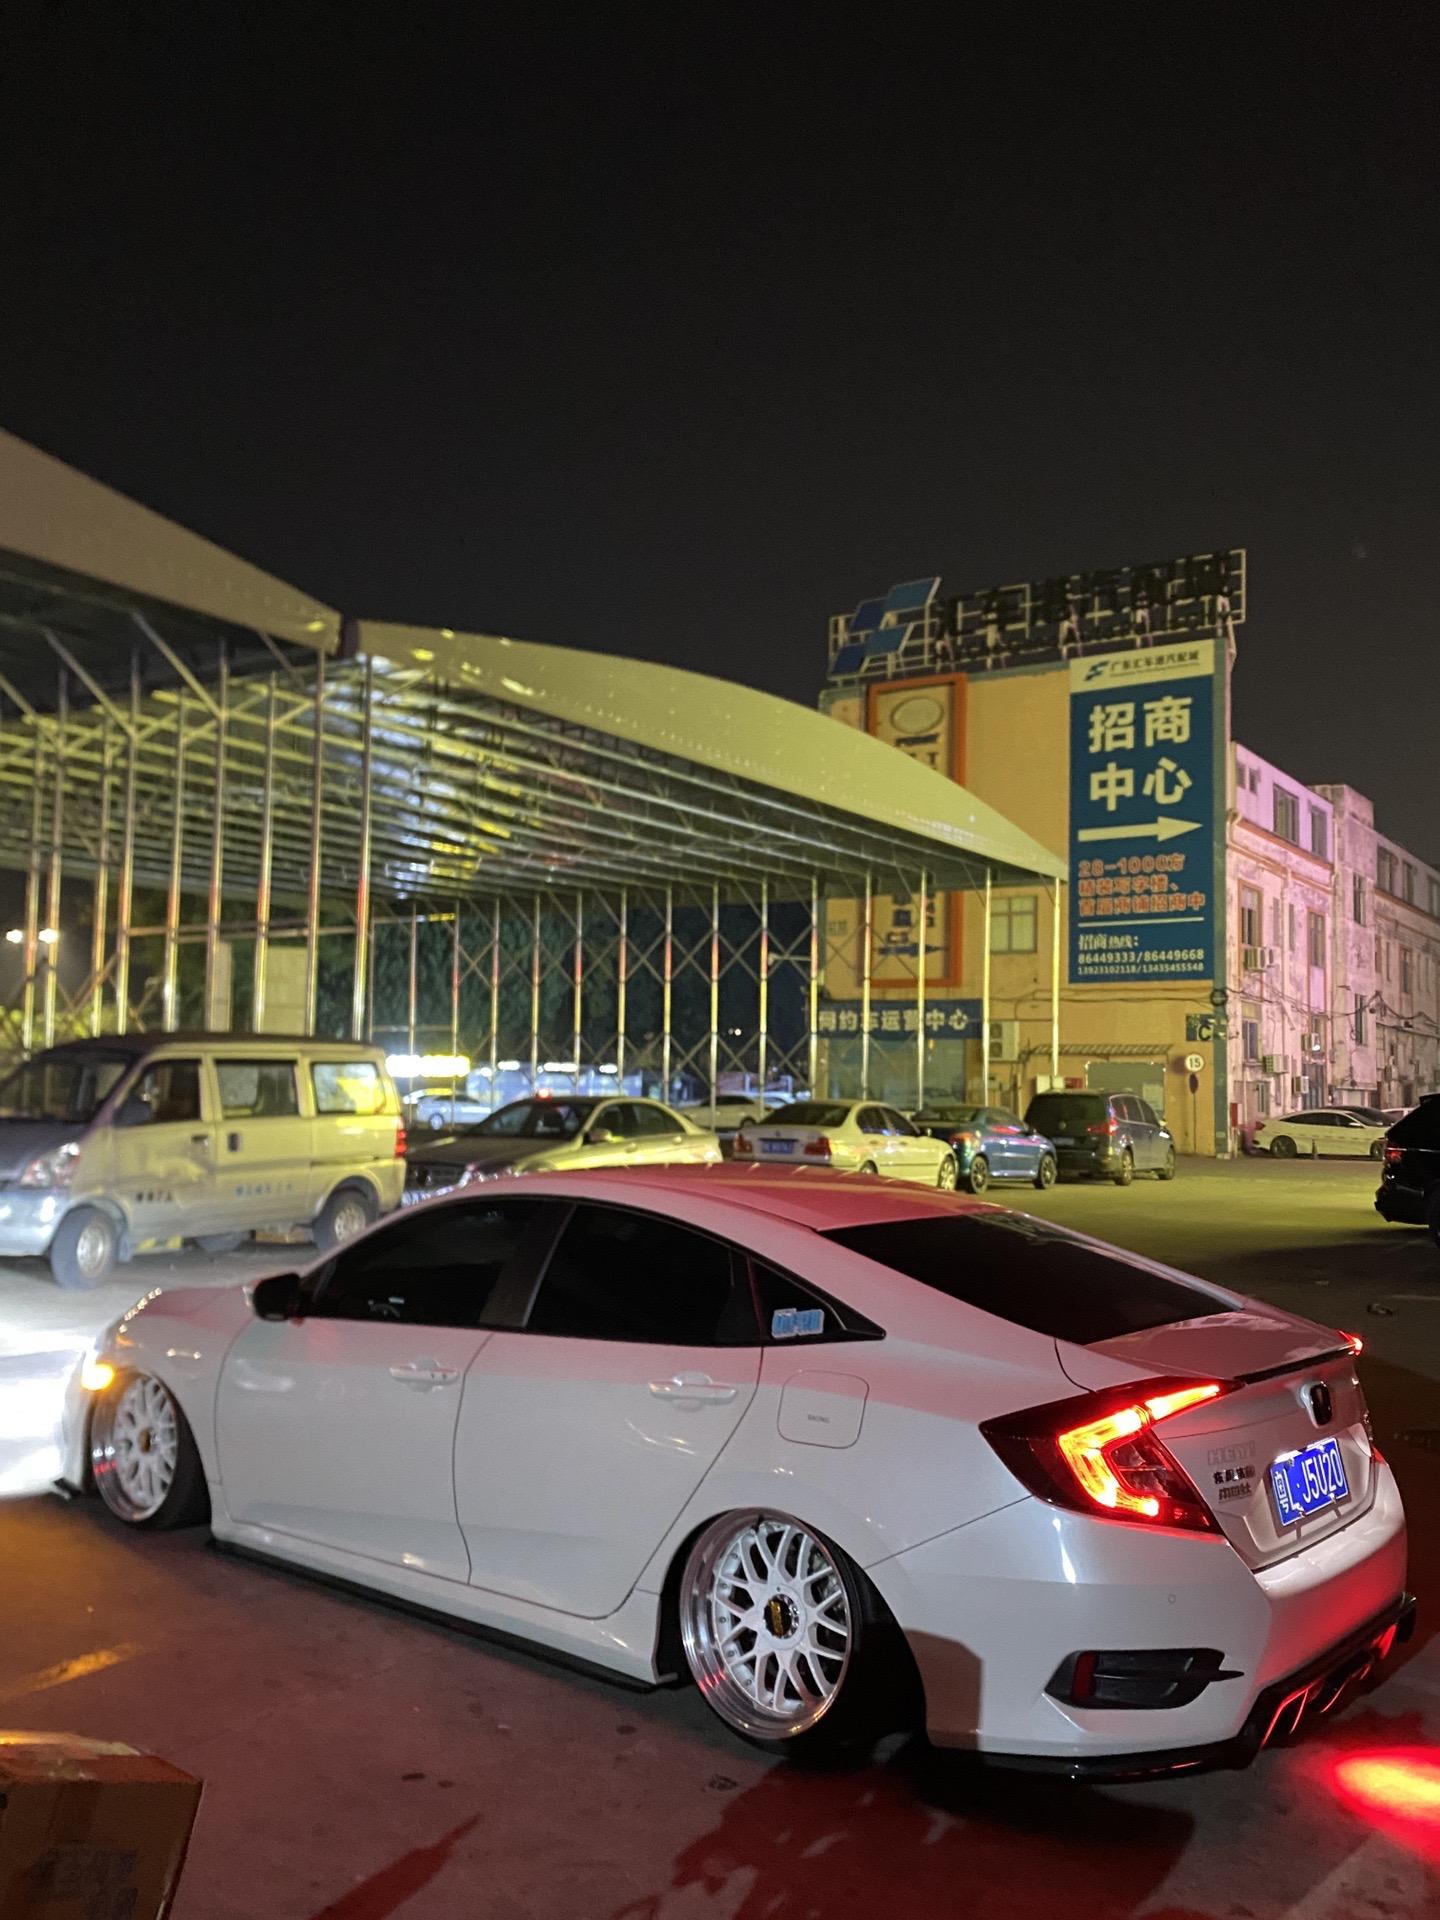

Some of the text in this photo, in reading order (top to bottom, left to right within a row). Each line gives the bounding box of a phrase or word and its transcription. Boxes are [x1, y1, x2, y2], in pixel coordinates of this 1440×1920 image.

[1088, 695, 1193, 753] 招商
[1090, 756, 1193, 812] 中心
[1189, 1057, 1202, 1069] 15
